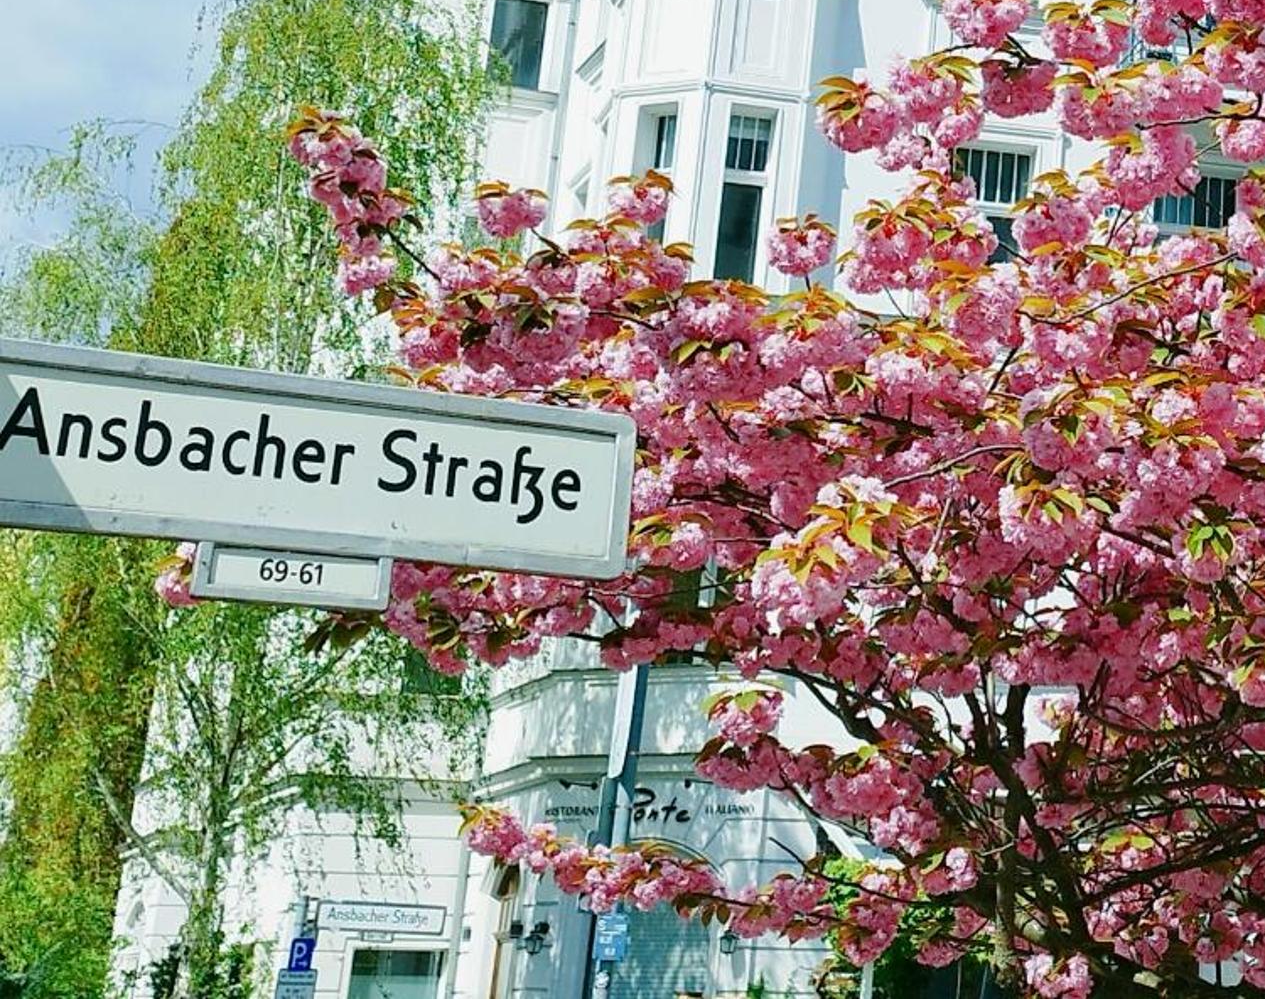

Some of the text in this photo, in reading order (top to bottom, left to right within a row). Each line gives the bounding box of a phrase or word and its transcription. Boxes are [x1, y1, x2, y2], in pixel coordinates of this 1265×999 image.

[0, 387, 582, 525] Ansbacher Straße
[258, 558, 325, 586] 69-61
[327, 907, 390, 924] Ansbacher
[291, 942, 308, 967] P
